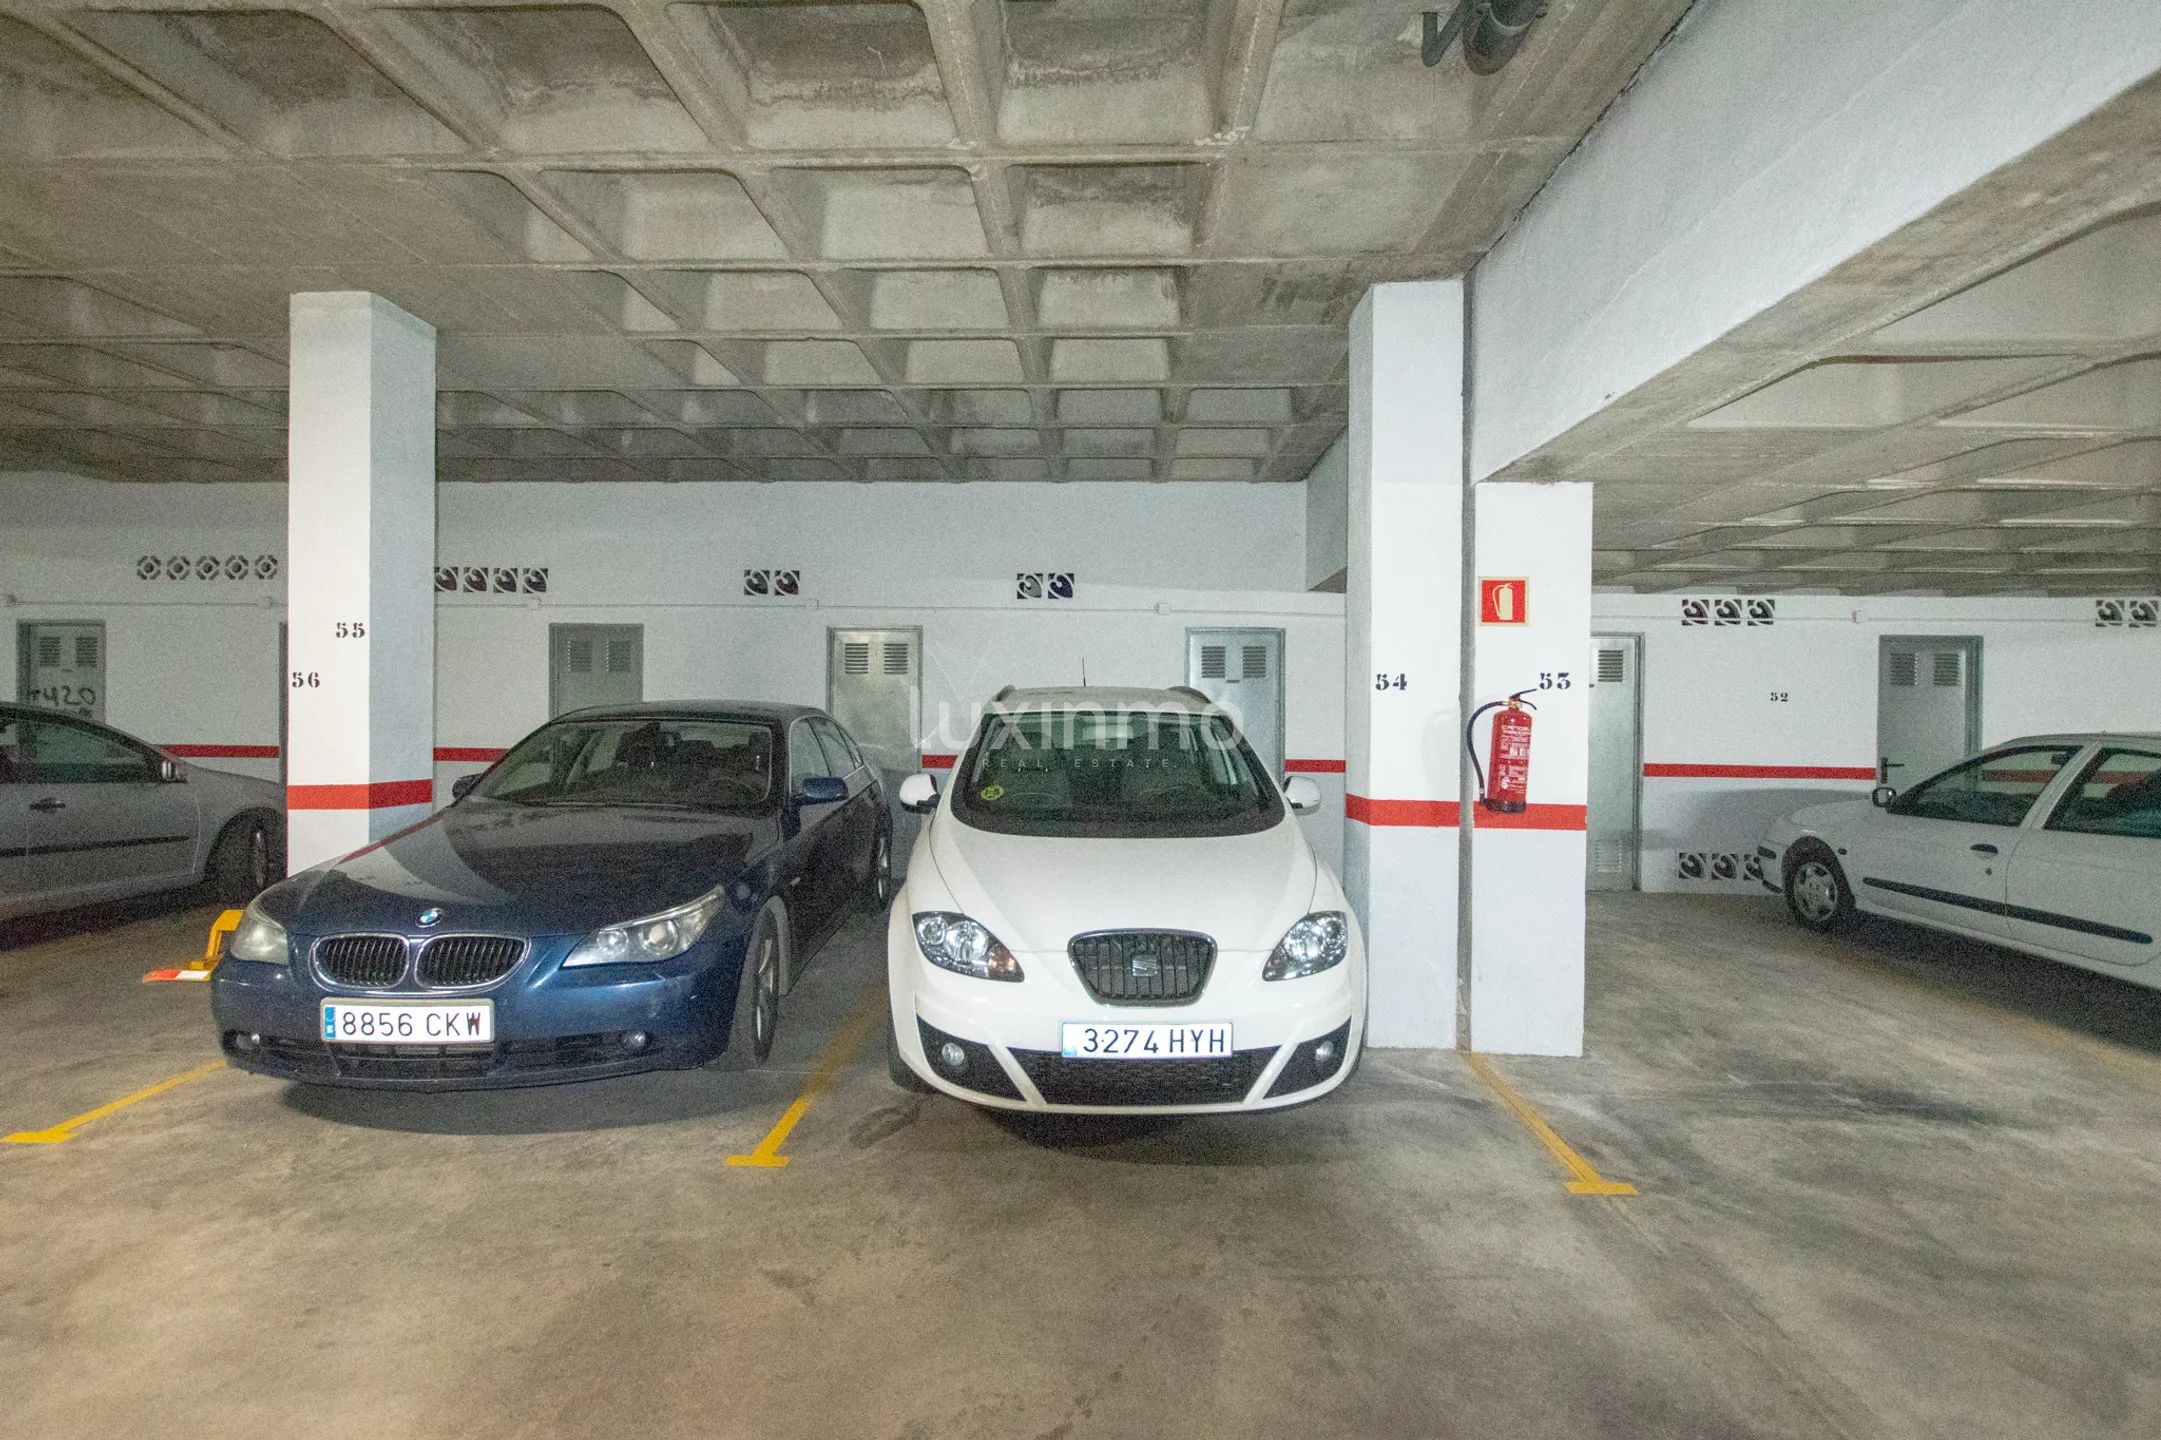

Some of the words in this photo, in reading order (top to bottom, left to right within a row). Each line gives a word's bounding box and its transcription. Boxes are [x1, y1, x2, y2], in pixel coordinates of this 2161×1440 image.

[336, 622, 365, 638] 55
[292, 672, 320, 688] 56
[1375, 673, 1408, 691] 54
[1539, 672, 1571, 690] 53
[1770, 692, 1788, 702] 52
[342, 1012, 413, 1036] 8856
[426, 1012, 481, 1036] CKW
[1083, 1028, 1159, 1053] 3274
[1169, 1029, 1224, 1053] HYH
